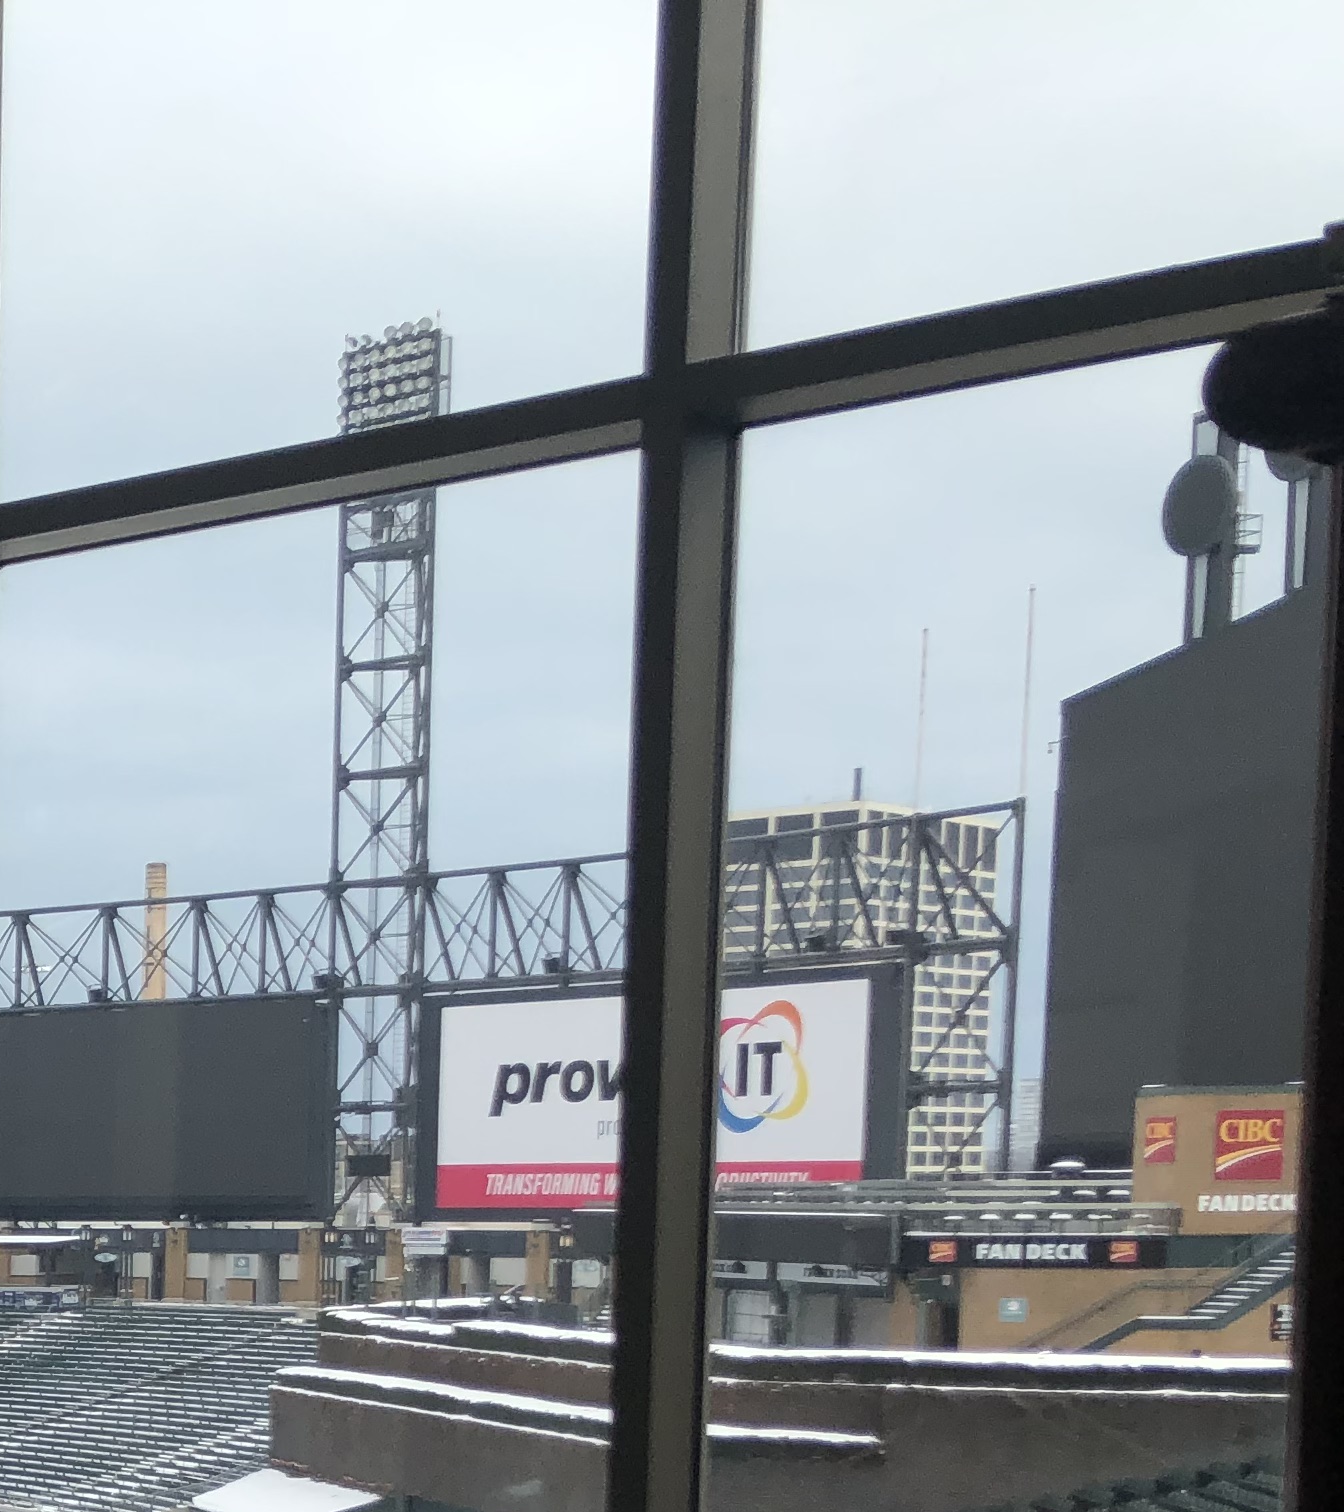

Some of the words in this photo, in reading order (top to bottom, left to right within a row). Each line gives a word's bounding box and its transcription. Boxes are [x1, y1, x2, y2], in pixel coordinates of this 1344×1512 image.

[488, 1059, 622, 1118] prov
[735, 1041, 783, 1097] IT
[1220, 1118, 1282, 1143] CIBC
[486, 1173, 600, 1196] TRANSFORMING
[1198, 1195, 1239, 1212] FAN
[1241, 1194, 1297, 1212] DECK
[975, 1243, 1023, 1260] FAN
[1025, 1243, 1087, 1260] DECK
